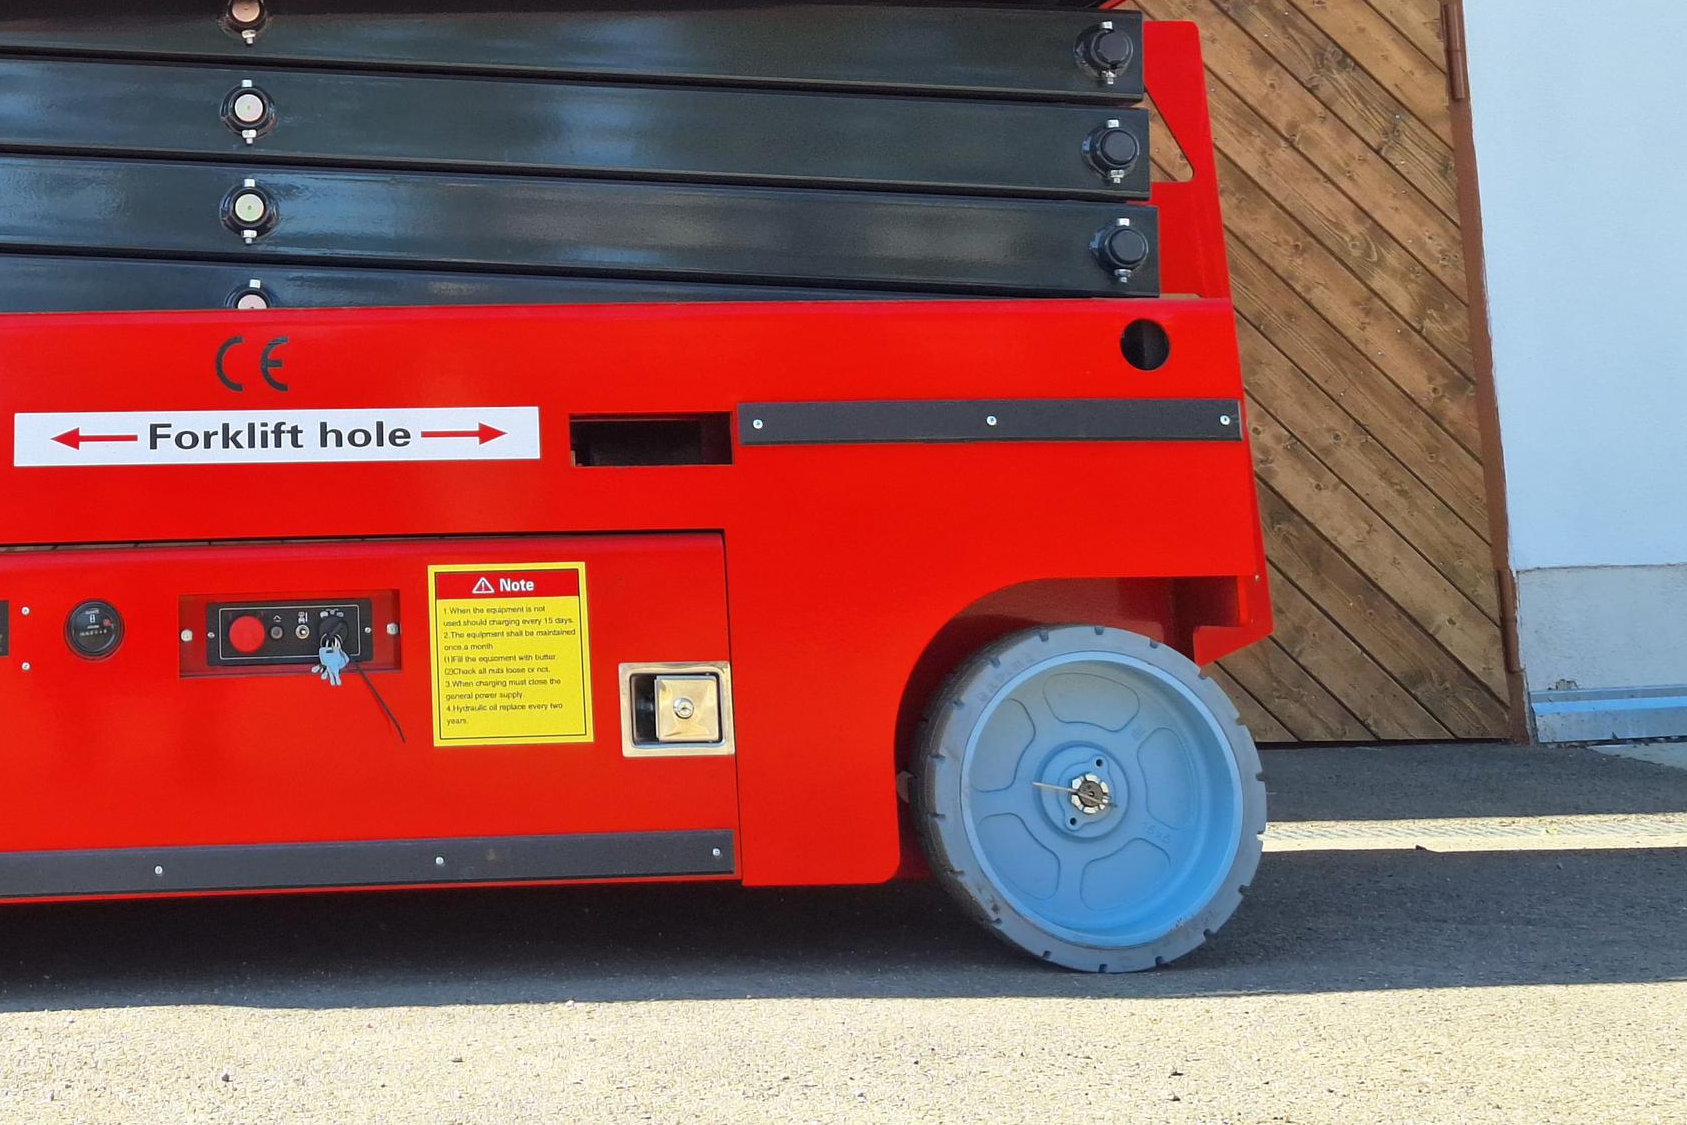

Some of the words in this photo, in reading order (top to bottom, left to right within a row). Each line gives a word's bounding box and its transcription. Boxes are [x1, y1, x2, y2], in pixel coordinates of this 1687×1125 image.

[149, 422, 304, 450] Forklift
[319, 421, 412, 448] hole
[499, 578, 535, 592] Note
[486, 606, 524, 615] equipment
[443, 619, 461, 627] used
[463, 618, 487, 626] should
[488, 618, 520, 626] charging
[466, 631, 504, 639] equipment
[506, 629, 523, 637] shall
[536, 628, 576, 636] maintained
[478, 655, 517, 663] equipment
[478, 666, 487, 674] all
[475, 679, 507, 688] charging
[445, 692, 473, 701] general
[474, 692, 497, 700] power
[499, 704, 526, 712] replace
[528, 703, 549, 711] every
